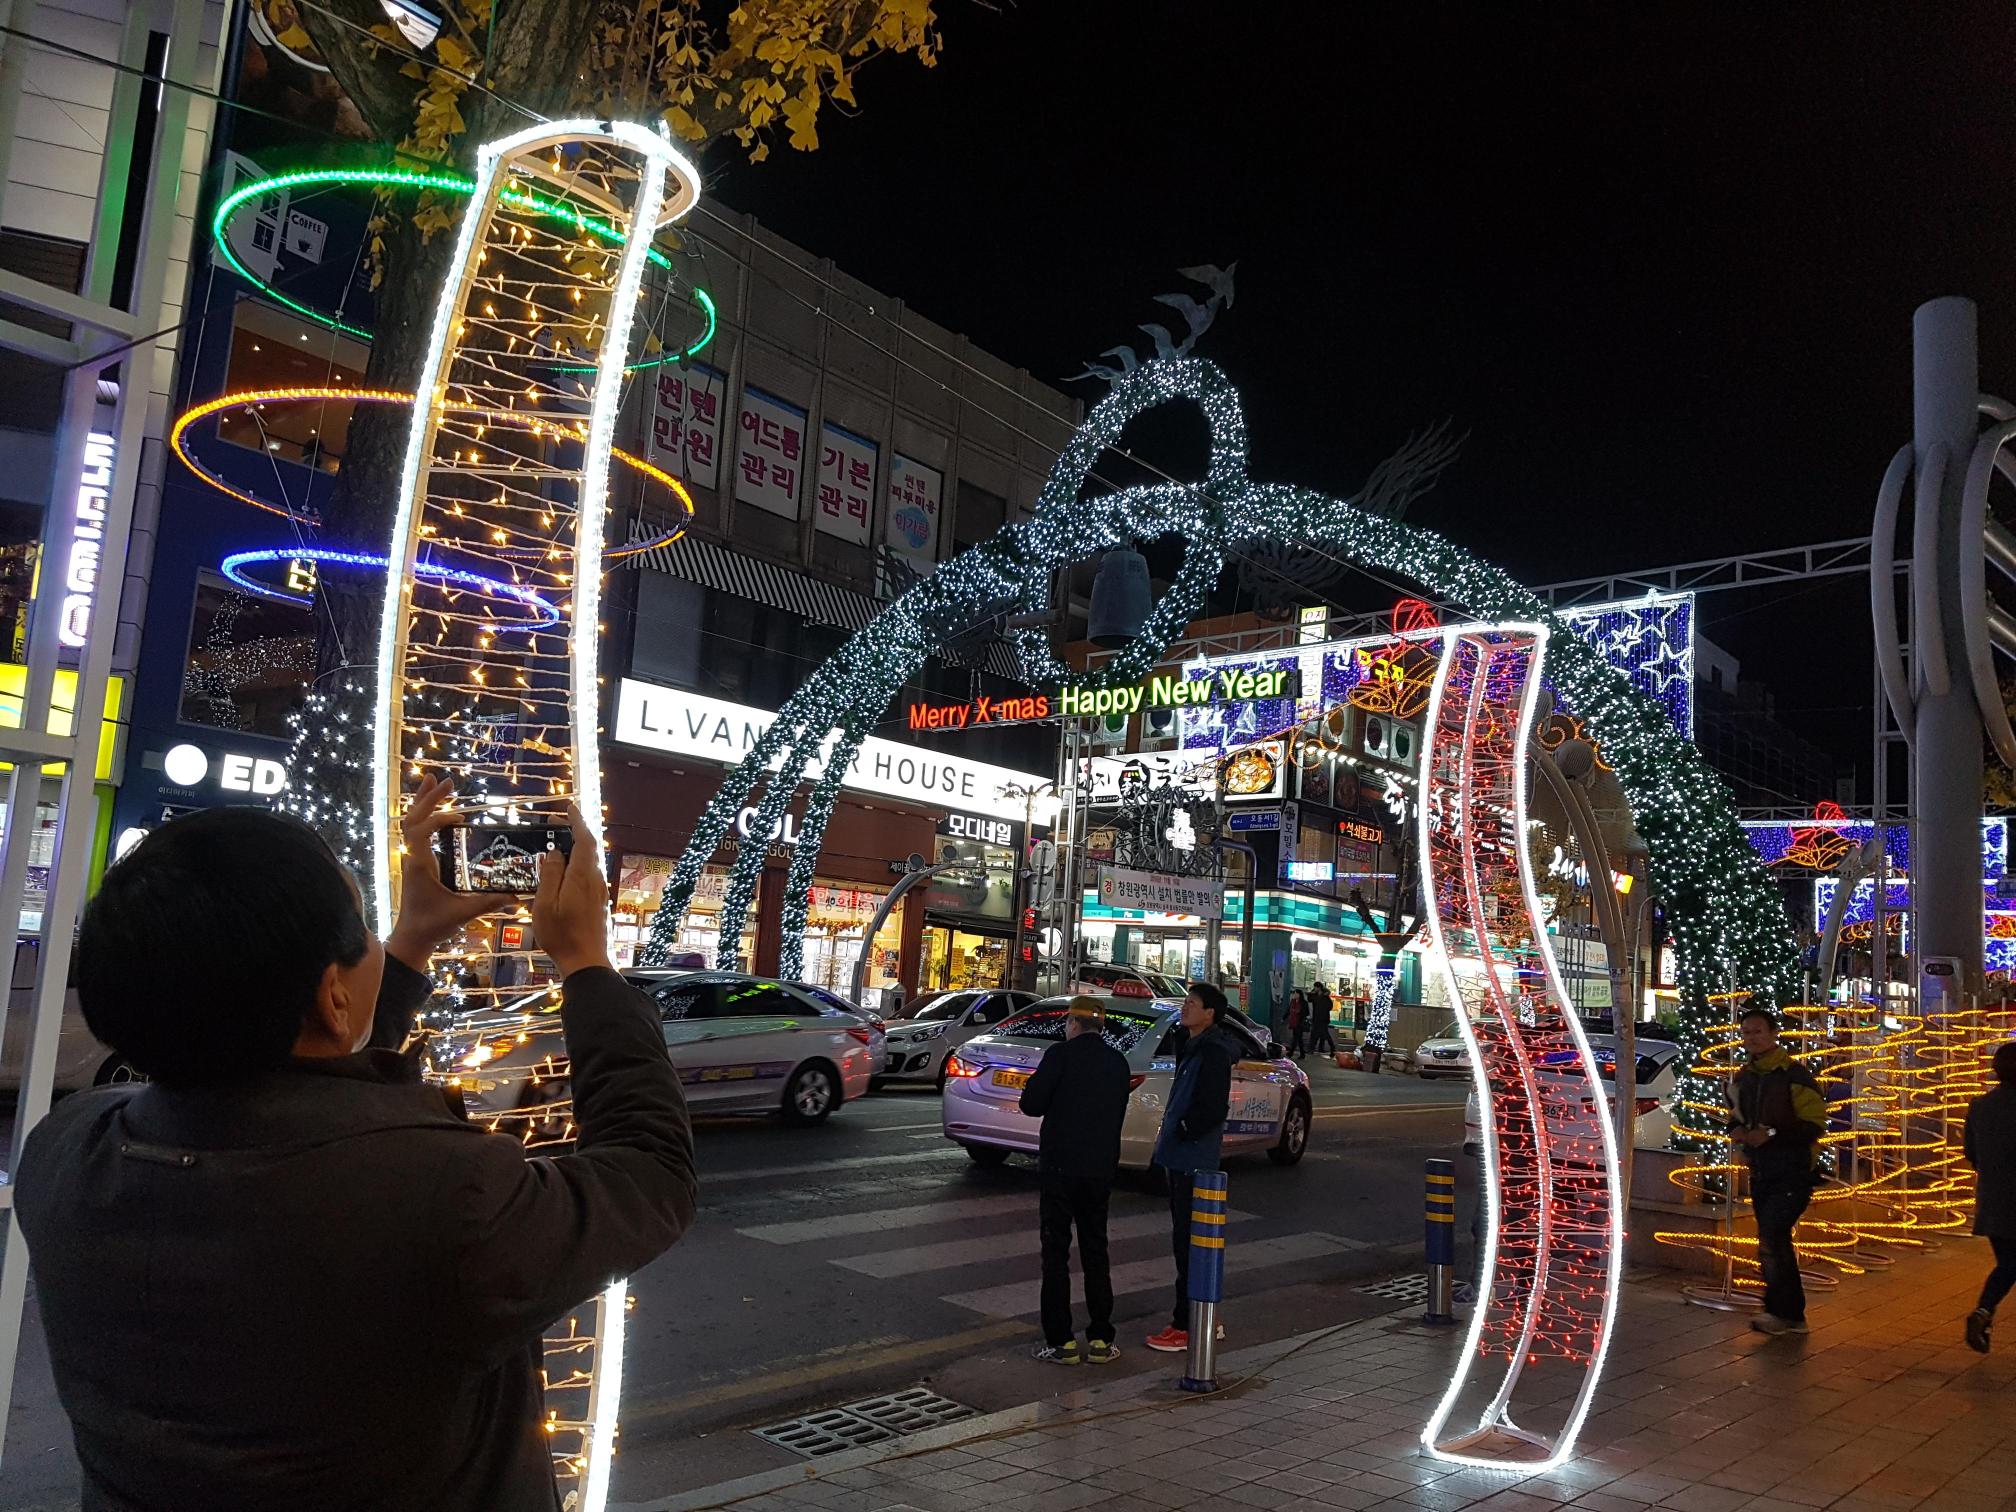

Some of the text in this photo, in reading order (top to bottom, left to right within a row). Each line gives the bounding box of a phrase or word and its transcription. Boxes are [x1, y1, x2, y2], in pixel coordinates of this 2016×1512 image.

[291, 214, 323, 234] COFFEE
[653, 414, 713, 467] 만원
[740, 452, 794, 499] 관리
[822, 446, 871, 491] 기본
[818, 484, 869, 528] 관리
[910, 696, 1048, 729] Merry X-mas
[1061, 669, 1287, 715] Happy New Year
[875, 752, 975, 798] HOUSE
[948, 814, 1012, 846] 모디네일
[1104, 880, 1113, 893] 경
[1117, 880, 1156, 900] 창원광역시
[1158, 886, 1172, 902] 설치
[1173, 888, 1195, 905] 법률안
[1196, 889, 1212, 907] 발의
